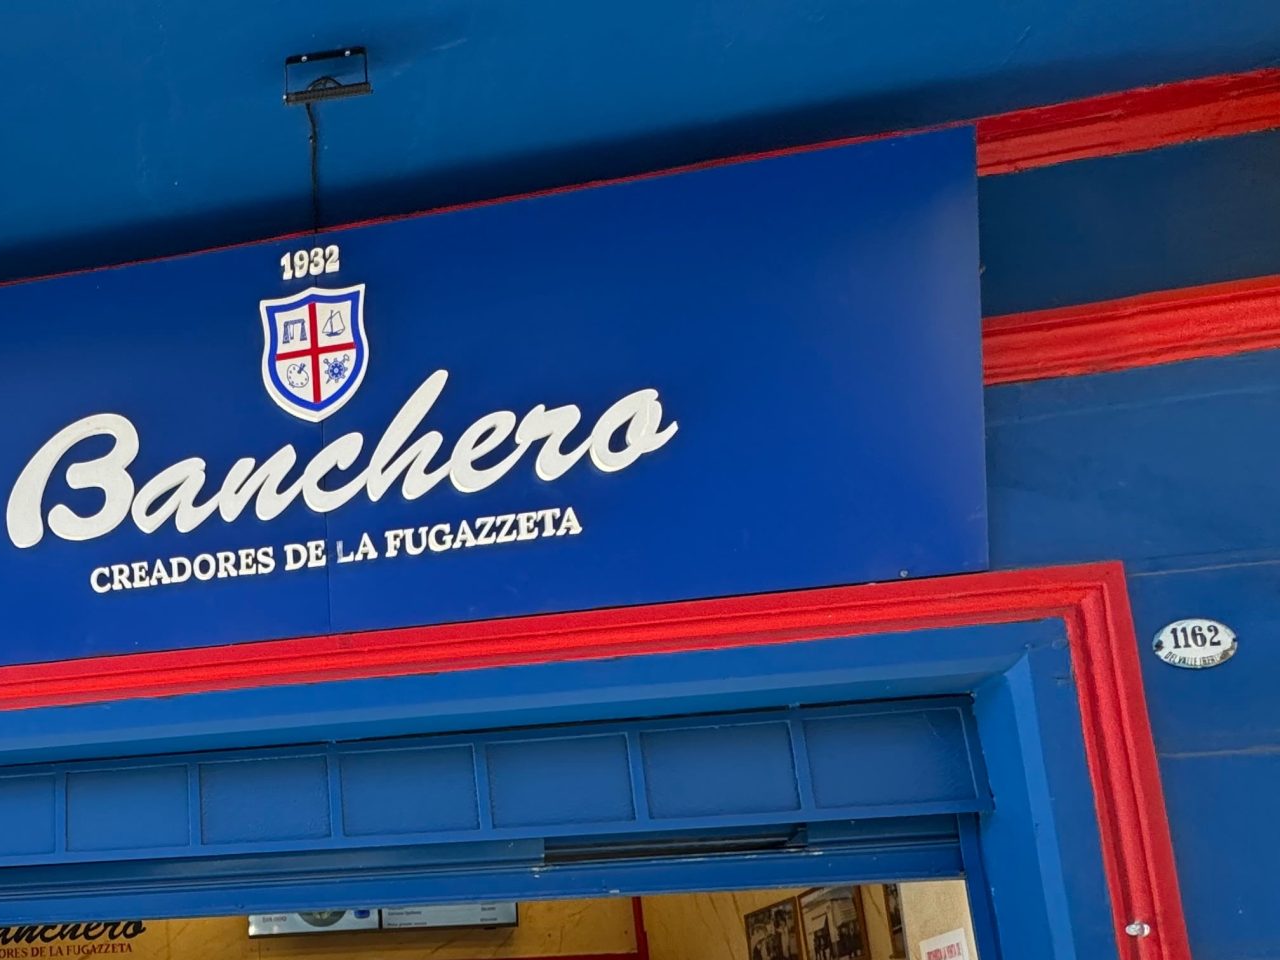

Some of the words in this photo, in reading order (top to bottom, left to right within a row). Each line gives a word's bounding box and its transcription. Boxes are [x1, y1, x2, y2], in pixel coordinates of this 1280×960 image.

[280, 245, 340, 280] 1932
[6, 369, 679, 549] Banchero
[89, 545, 275, 594] CREADORES
[284, 541, 326, 570] DE
[336, 533, 380, 565] LA
[384, 506, 583, 557] FUGAZZETA
[1170, 624, 1222, 649] 1162
[31, 946, 46, 958] DE
[49, 945, 64, 957] LA
[66, 942, 133, 956] FUGAZZETA
